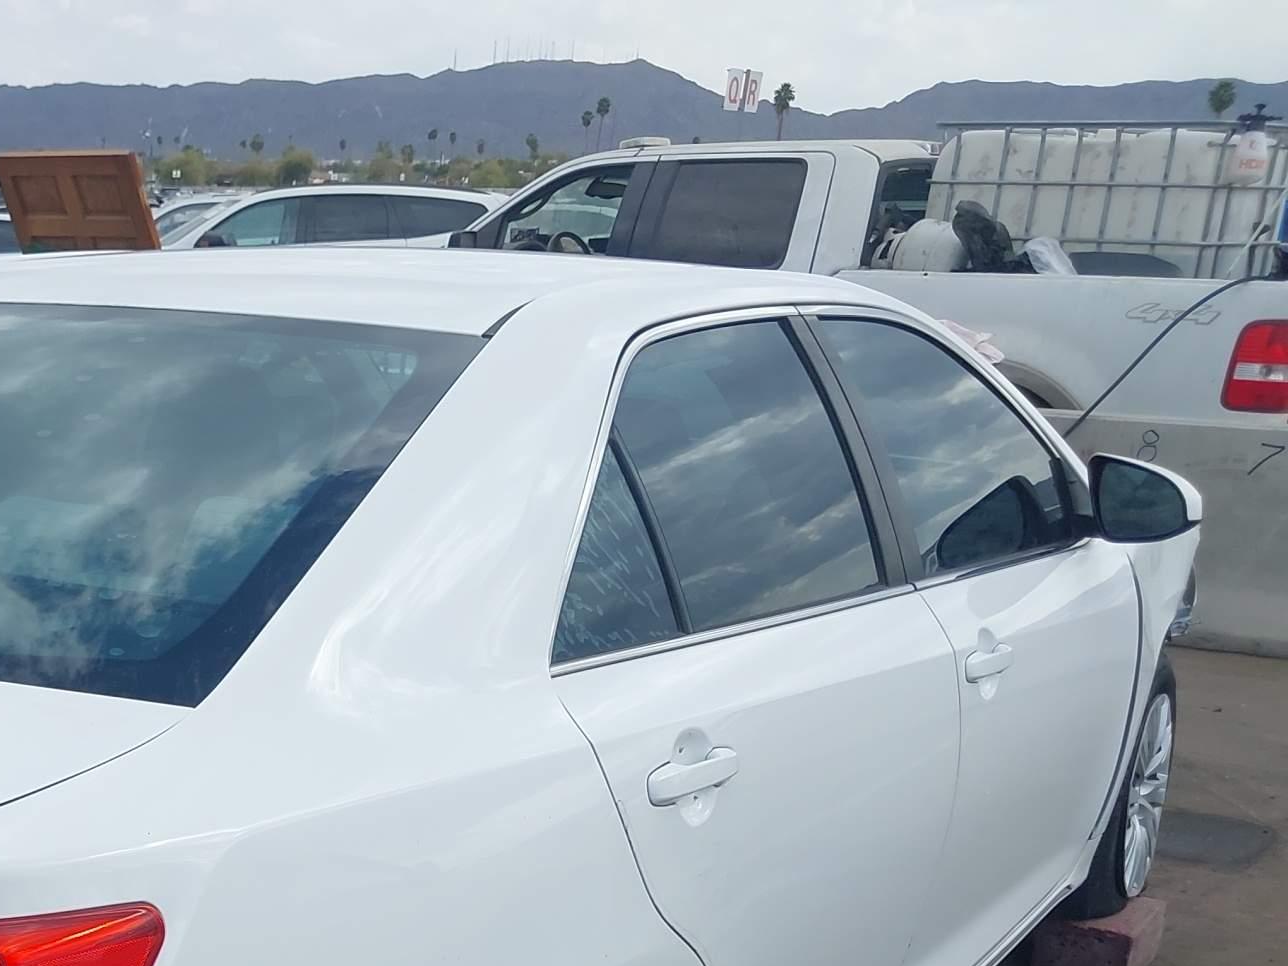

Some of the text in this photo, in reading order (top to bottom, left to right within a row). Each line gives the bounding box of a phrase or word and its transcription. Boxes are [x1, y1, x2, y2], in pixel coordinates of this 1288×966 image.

[728, 76, 740, 105] Q
[746, 79, 758, 106] R
[1136, 429, 1286, 476] 8 7
